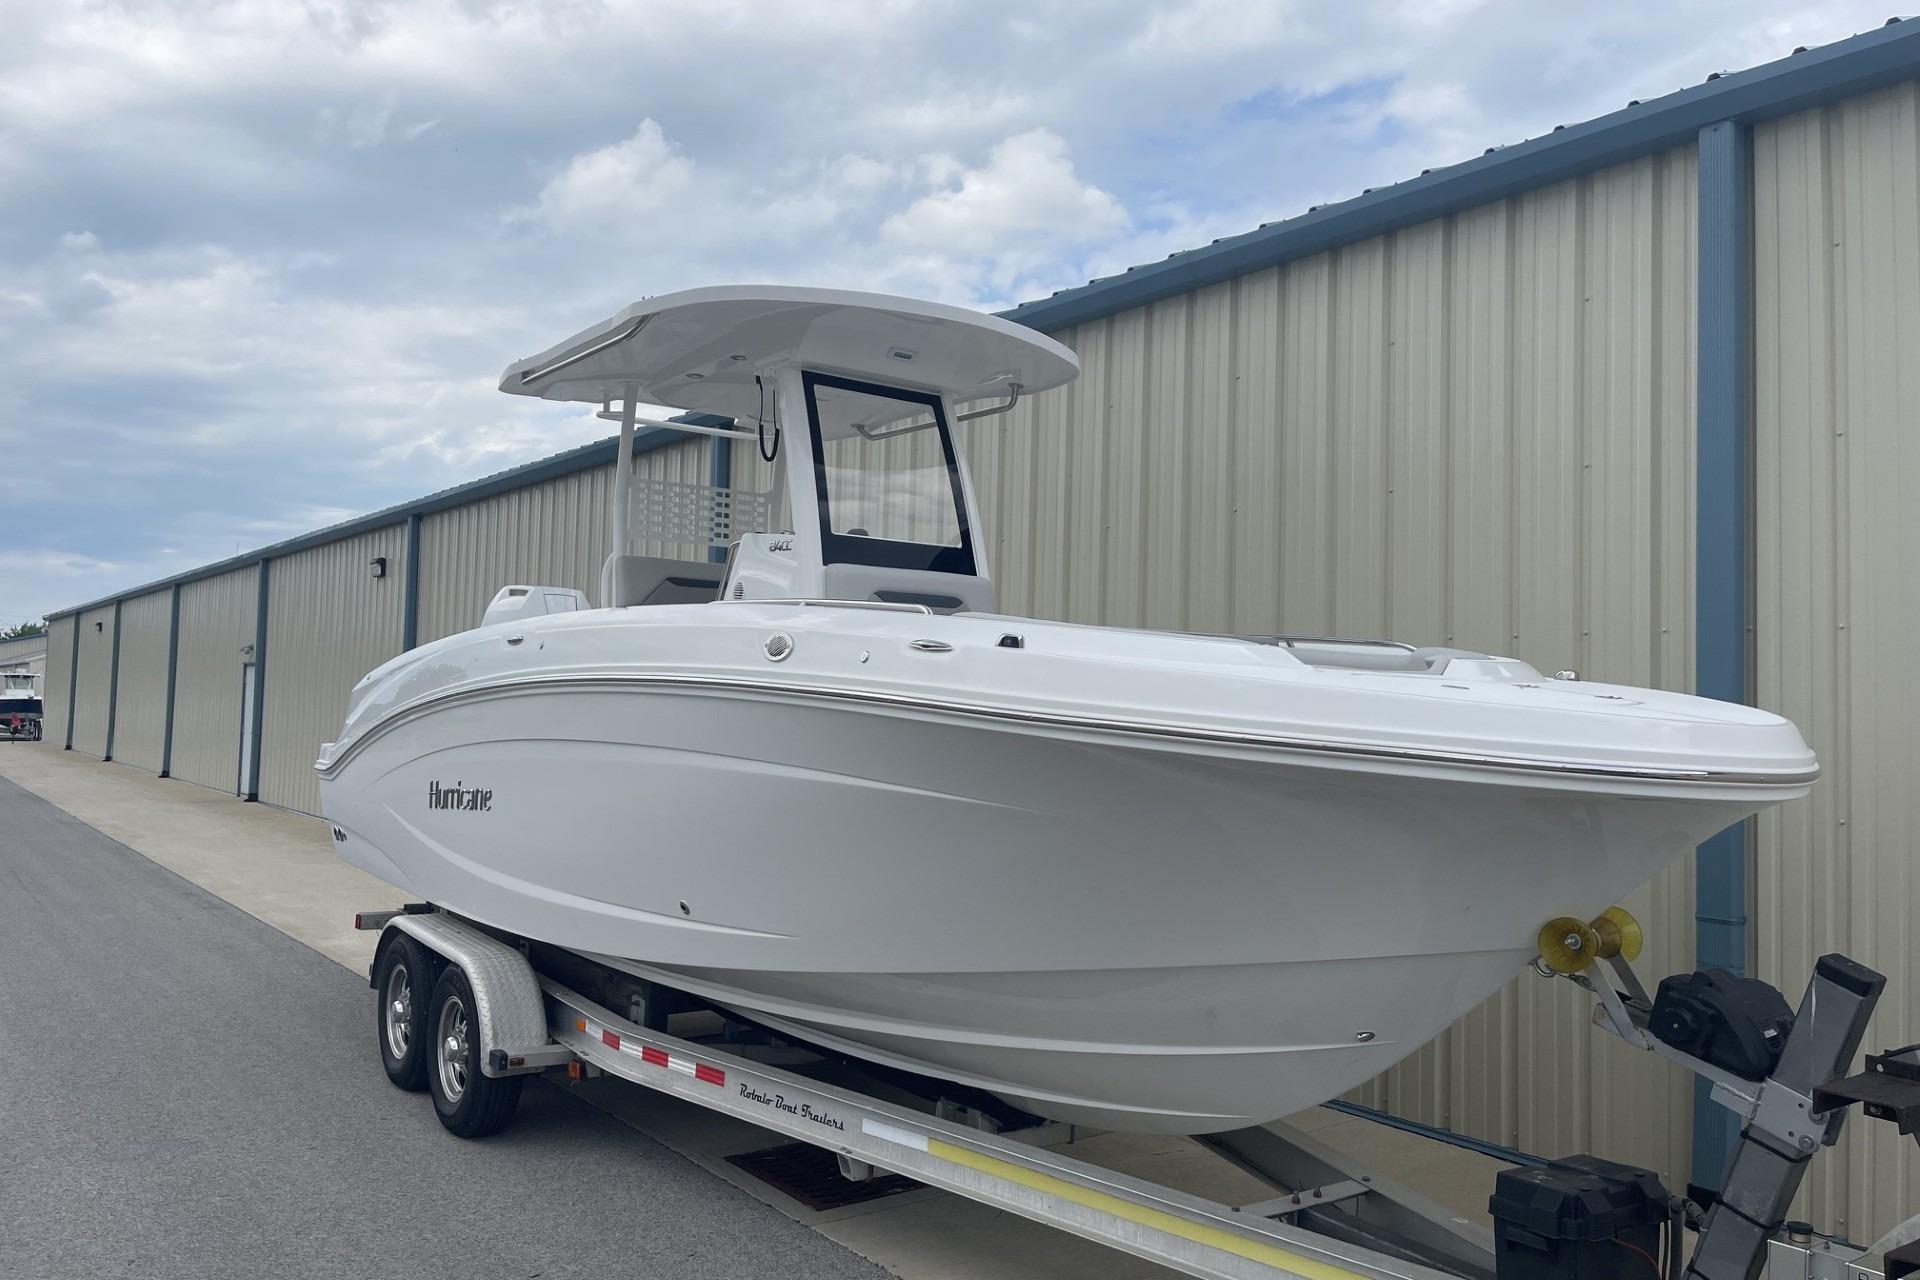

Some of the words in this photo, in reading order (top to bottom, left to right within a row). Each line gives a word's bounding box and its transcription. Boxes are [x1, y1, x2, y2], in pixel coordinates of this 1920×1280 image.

[428, 780, 493, 811] Hurricane
[739, 1083, 773, 1105] Robalo
[775, 1095, 798, 1115] Boat
[801, 1104, 845, 1131] Trailers
